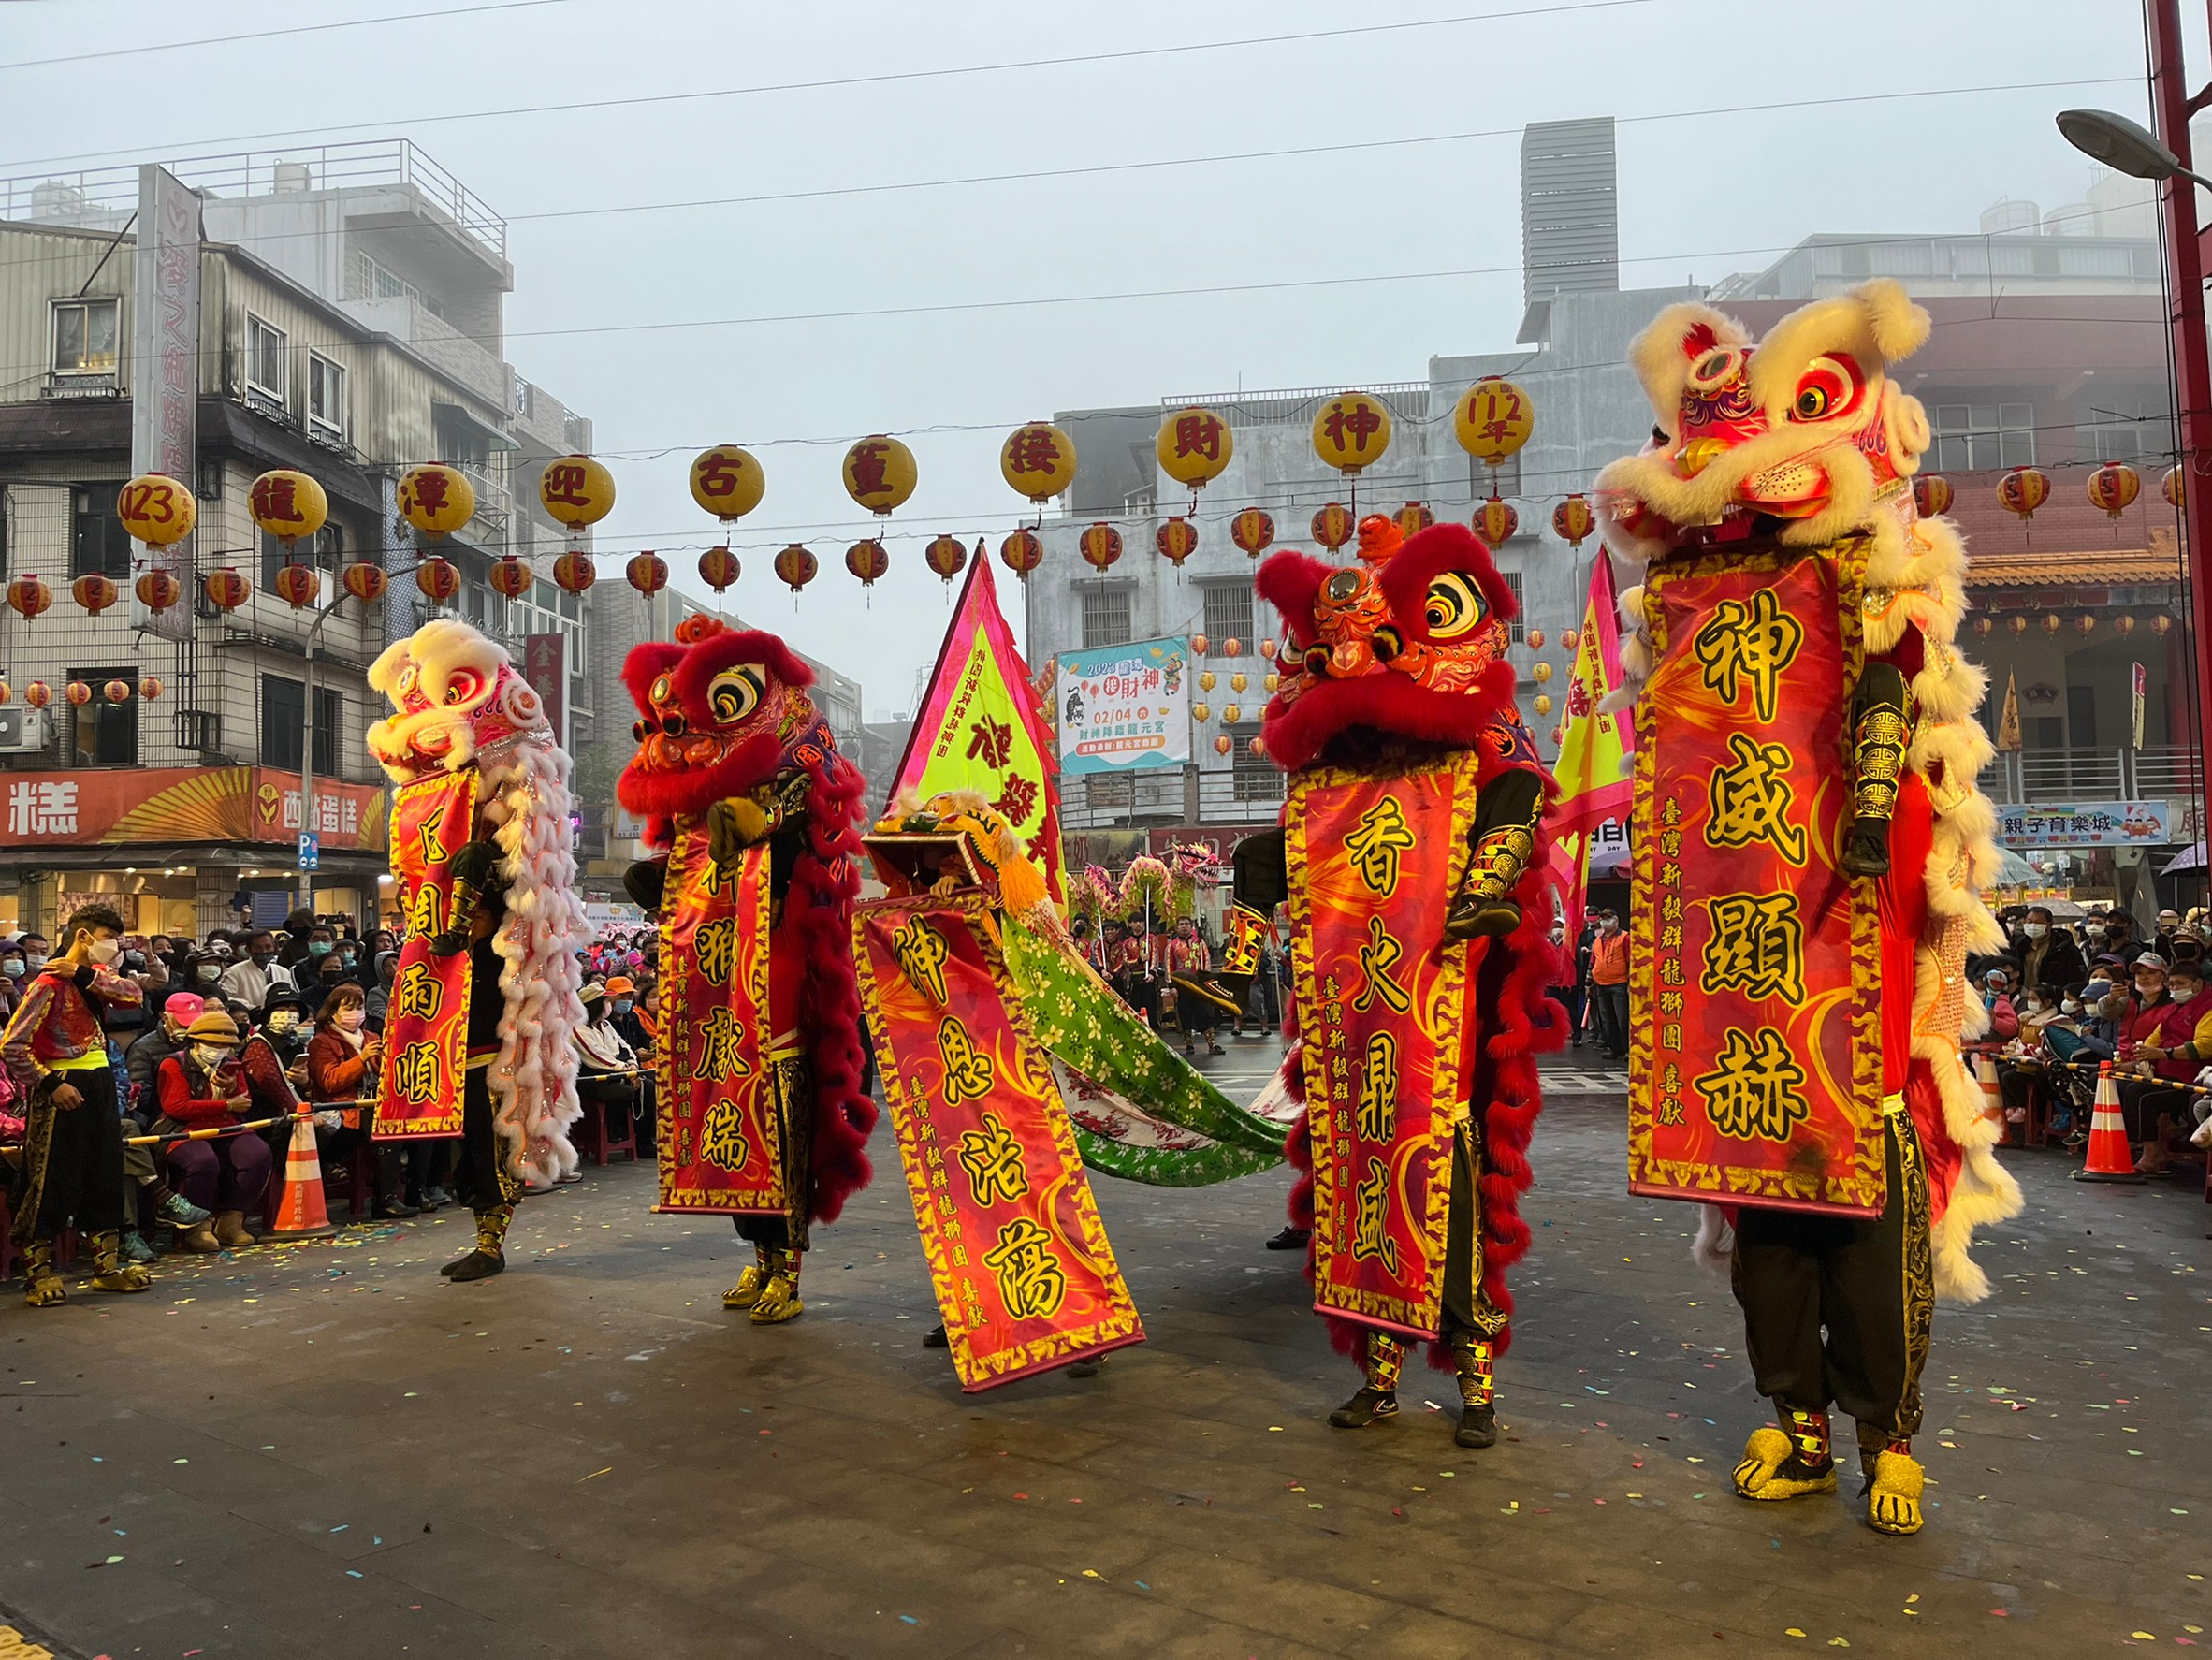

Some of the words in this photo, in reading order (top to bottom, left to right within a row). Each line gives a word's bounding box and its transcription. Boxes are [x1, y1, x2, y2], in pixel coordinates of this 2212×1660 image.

[1324, 403, 1381, 452] 神
[1468, 394, 1521, 424] 112
[1008, 429, 1061, 474] 接
[1175, 415, 1224, 461] 財
[1477, 421, 1517, 444] 年
[545, 464, 591, 507] 迎
[697, 453, 742, 497] 古
[850, 443, 894, 497] 董
[251, 477, 305, 522] 龍
[400, 471, 449, 517] 潭
[1087, 661, 1116, 677] 2023
[1118, 657, 1143, 676] 龍潭
[1103, 667, 1159, 700] 接財神
[1094, 707, 1131, 724] 02/04
[8, 781, 79, 836] 糕
[2004, 814, 2113, 835] 親子育樂城
[299, 835, 311, 855] P
[1692, 587, 1810, 1144] 神威顯赫
[1657, 796, 1685, 1053] 臺灣新毅群龍獅團
[1343, 794, 1417, 1276] 香火鼎盛
[1322, 974, 1352, 1189] 臺灣新毅群龍獅團
[1657, 1063, 1687, 1125] 喜獻
[892, 912, 1067, 1322] 神恩浩蕩
[910, 1075, 969, 1268] 臺灣新毅群龍獅團
[961, 1276, 990, 1330] 喜獻
[1333, 1203, 1348, 1254] 喜獻
